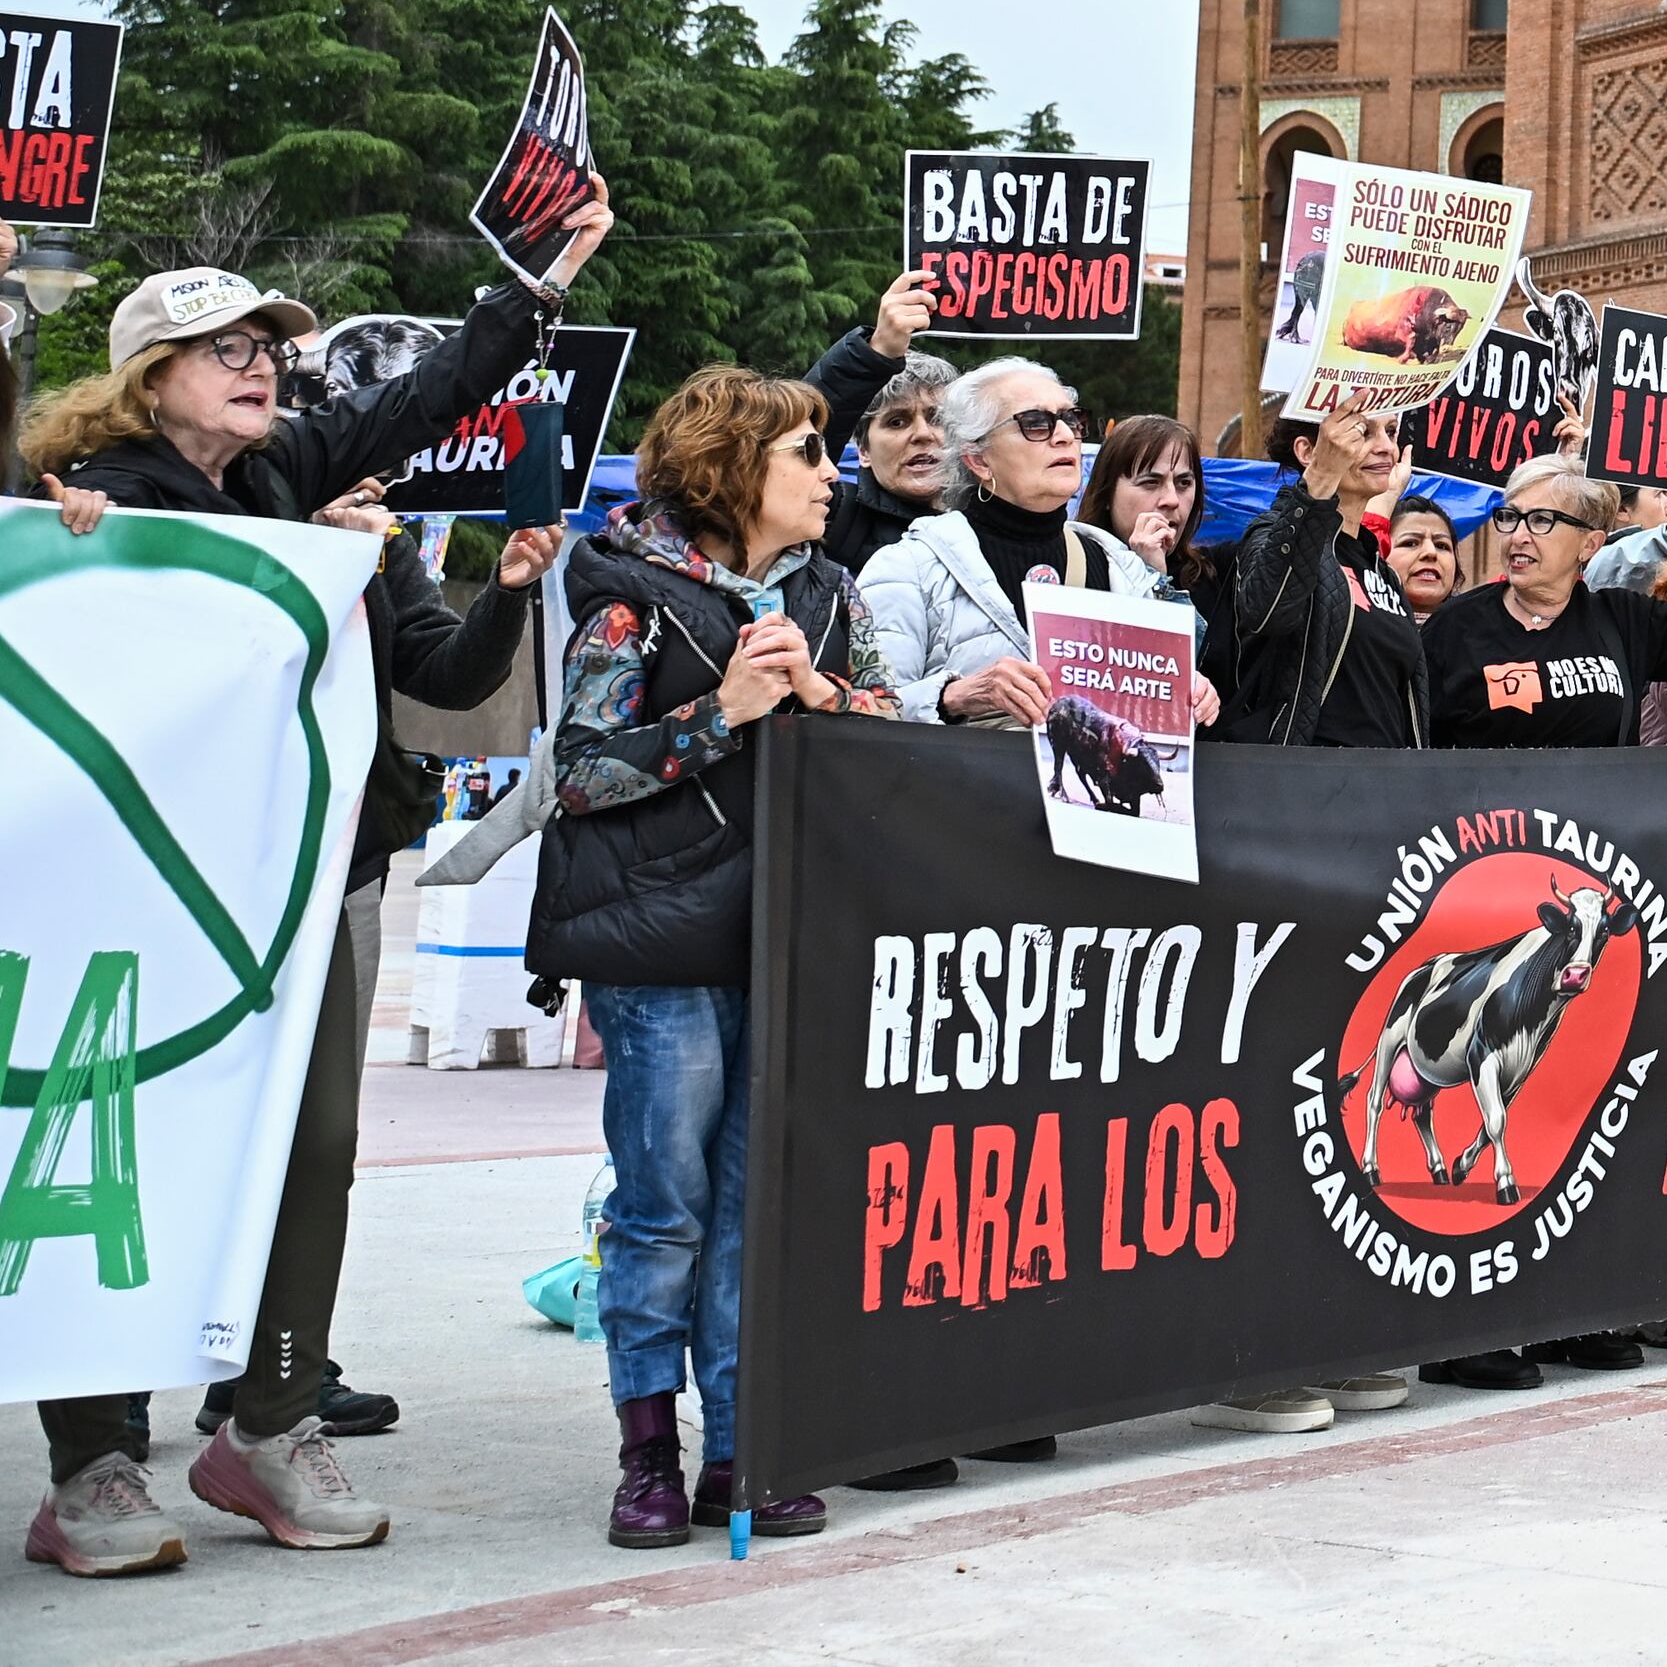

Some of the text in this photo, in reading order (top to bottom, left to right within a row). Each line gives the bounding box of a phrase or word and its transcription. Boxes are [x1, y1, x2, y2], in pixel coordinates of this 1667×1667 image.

[923, 168, 1136, 247] BASTA DE
[1353, 178, 1513, 227] SÓLO UN SÁDICO
[1350, 206, 1508, 251] PUEDE DISFRUTAR
[1411, 238, 1443, 255] CON EL
[921, 250, 1131, 321] ESPECISMO
[1343, 243, 1501, 285] SUFRIMIENTO AJENO
[1304, 381, 1342, 414] LA
[1314, 367, 1340, 382] PARA
[1394, 372, 1408, 385] NO
[1407, 371, 1430, 385] HACE
[1455, 343, 1553, 417] OROS
[1427, 395, 1541, 473] VIVOS
[1049, 637, 1180, 677] ESTO NUNCA
[1546, 658, 1573, 677] NO
[1574, 656, 1601, 675] ES
[1060, 665, 1173, 701] SERÁ ARTE
[1549, 672, 1625, 700] CULTURA
[1344, 825, 1458, 976] UNIÓN
[1455, 807, 1528, 855] ANTI
[864, 921, 1298, 1094] RESPETO Y
[1292, 1046, 1660, 1299] VEGANISMO ES JUSTICIA
[862, 1097, 1241, 1313] PARA LOS
